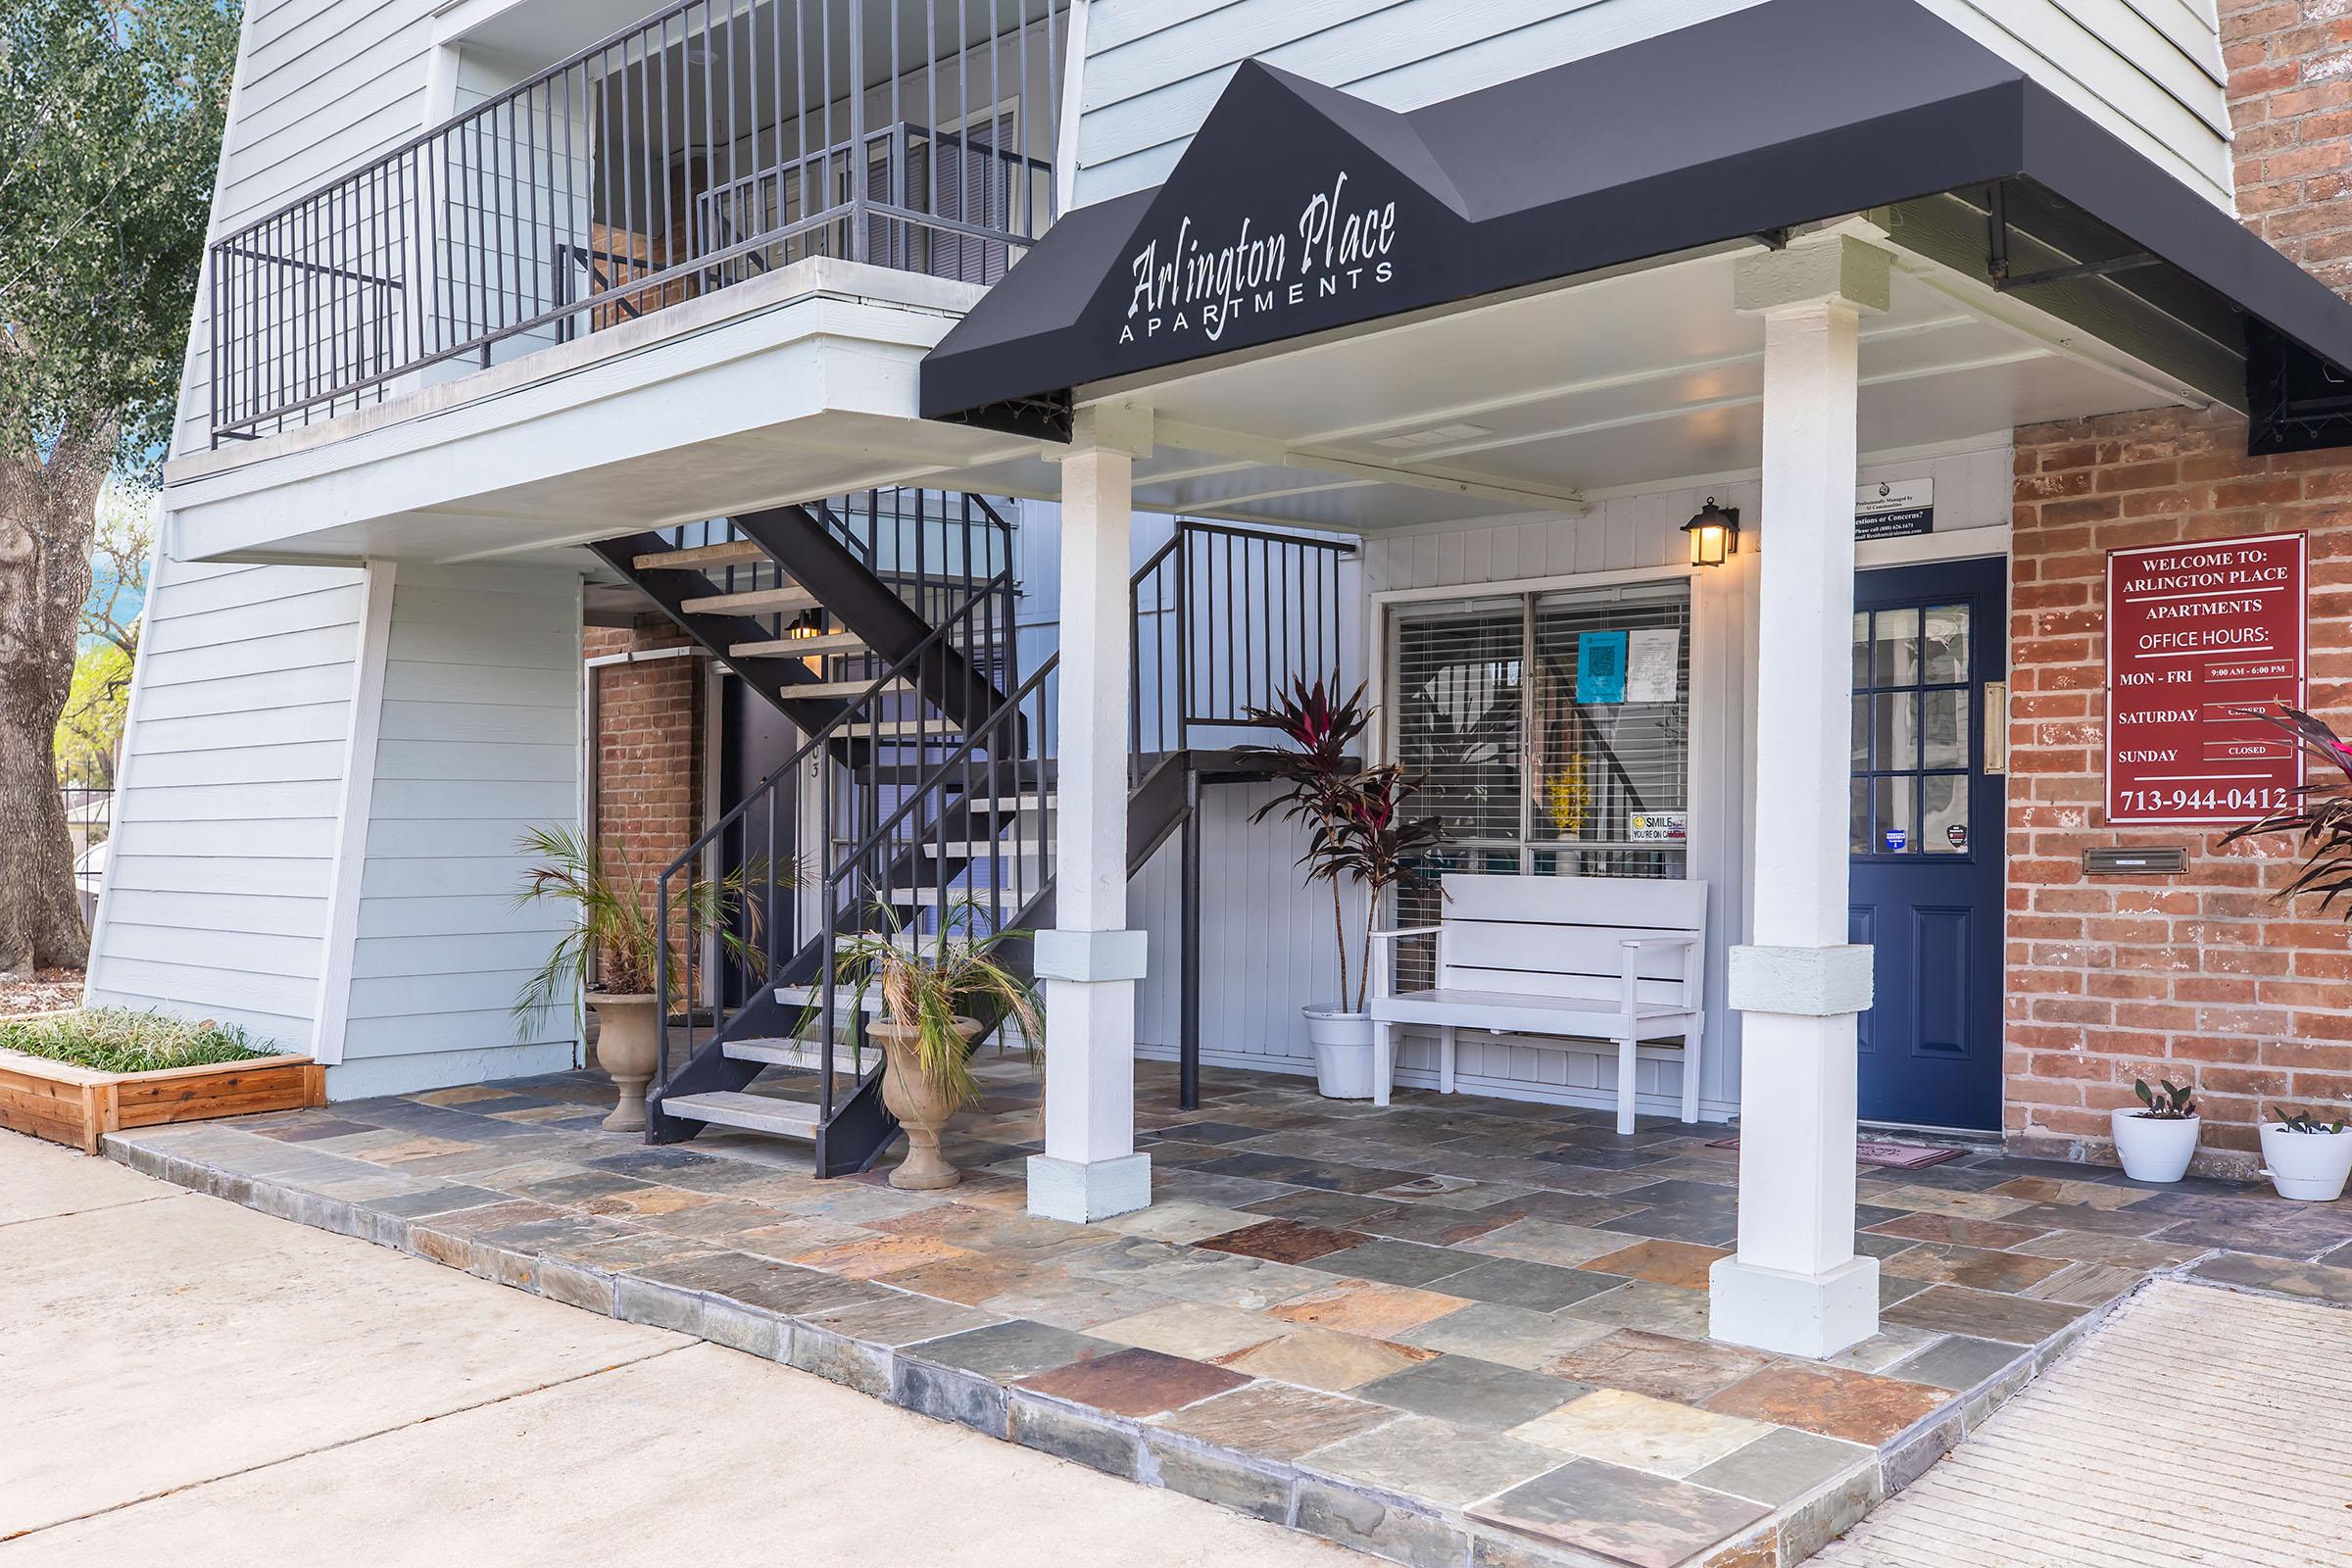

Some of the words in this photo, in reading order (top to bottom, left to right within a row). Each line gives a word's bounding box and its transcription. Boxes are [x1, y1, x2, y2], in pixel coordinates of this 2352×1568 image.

[1128, 217, 1285, 341] Arlington
[1299, 171, 1396, 274] Place
[1118, 261, 1393, 344] APARTMENTS
[1887, 511, 1924, 521] Concerns?
[2143, 552, 2233, 572] WELCOME
[2237, 550, 2268, 563] TO:
[2123, 572, 2225, 593] ARLINGTON
[2230, 566, 2288, 583] PLACE
[2145, 599, 2263, 620] APARTMENTS
[2139, 631, 2198, 650] OFFICE
[2203, 626, 2269, 645] HOURS:
[2271, 664, 2285, 673] PM
[2120, 672, 2155, 686] MON
[2167, 670, 2192, 684] FRI
[2119, 710, 2198, 724] SATURDAY
[2118, 750, 2179, 763] SUNDAY
[2228, 746, 2266, 755] CLOSED
[2120, 788, 2288, 811] 713-944-0412
[1646, 817, 1672, 827] SMILE
